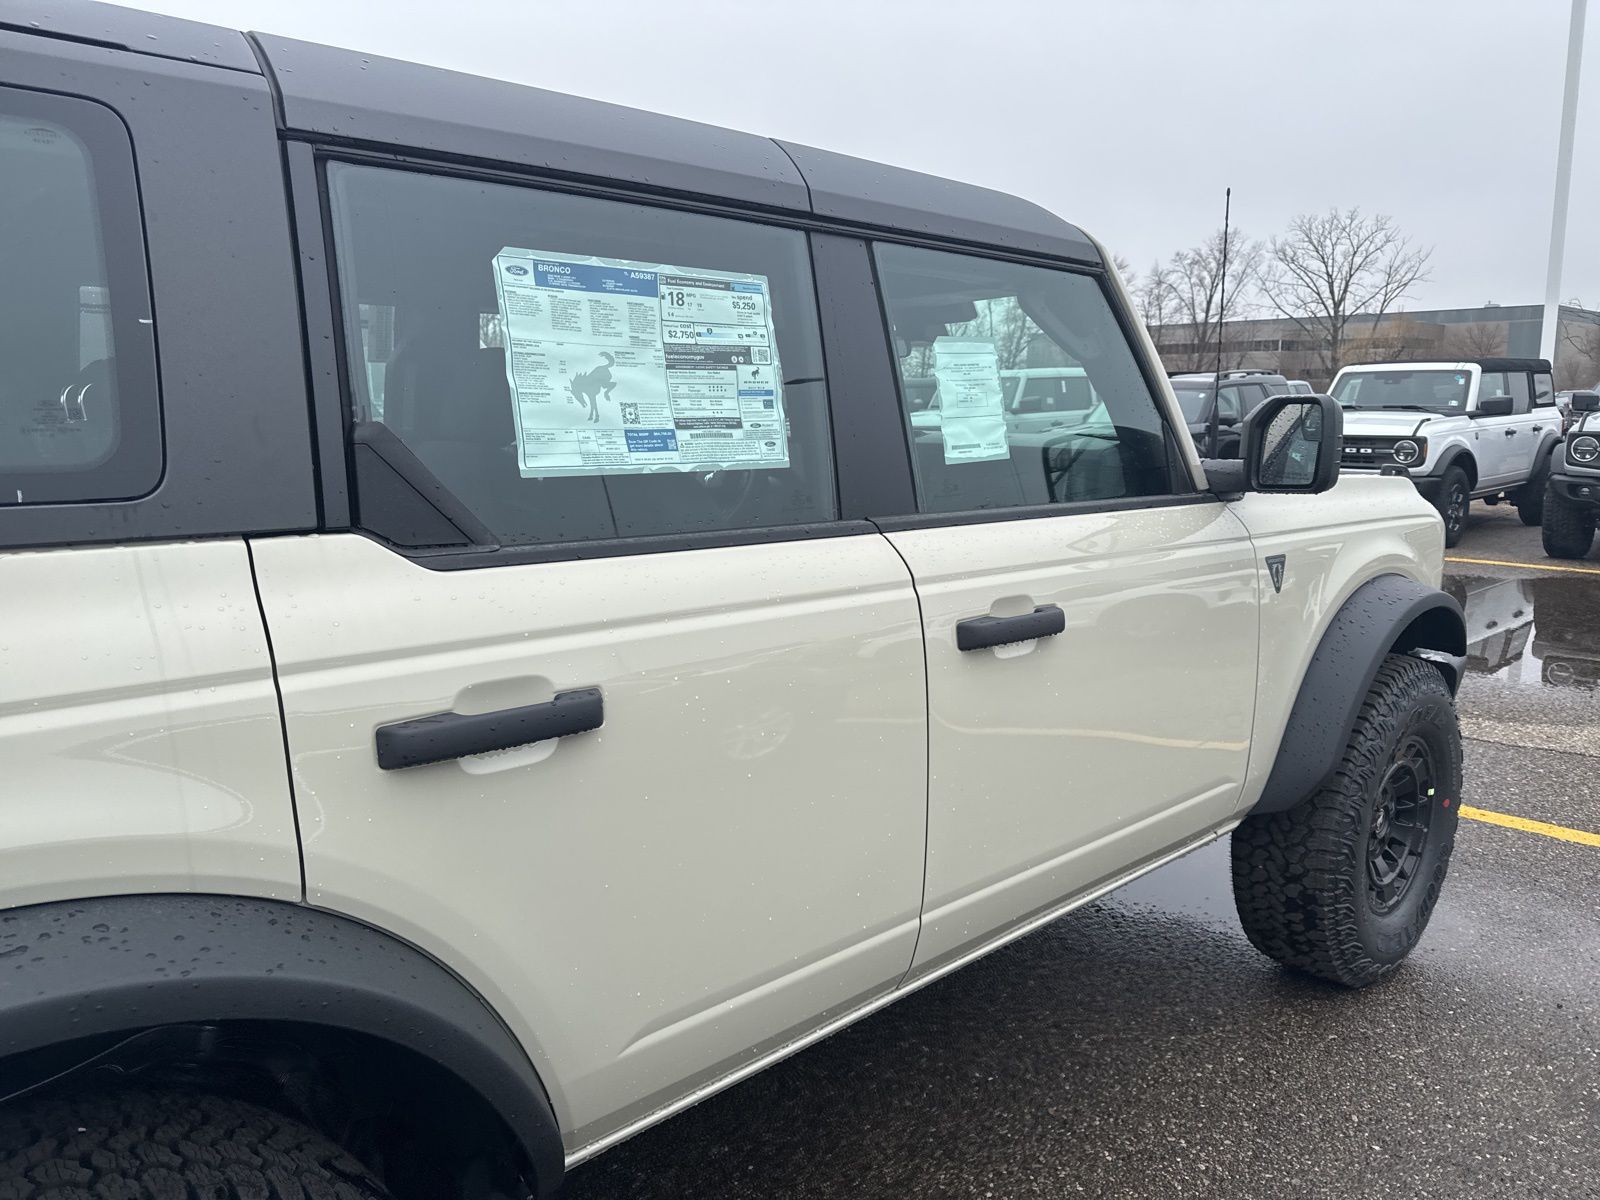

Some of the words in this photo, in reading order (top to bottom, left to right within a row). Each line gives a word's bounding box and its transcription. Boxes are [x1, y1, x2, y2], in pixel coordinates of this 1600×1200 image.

[538, 264, 571, 274] BRONCO
[668, 291, 685, 307] 18
[732, 301, 756, 310] $5,250
[668, 330, 694, 339] $2,750
